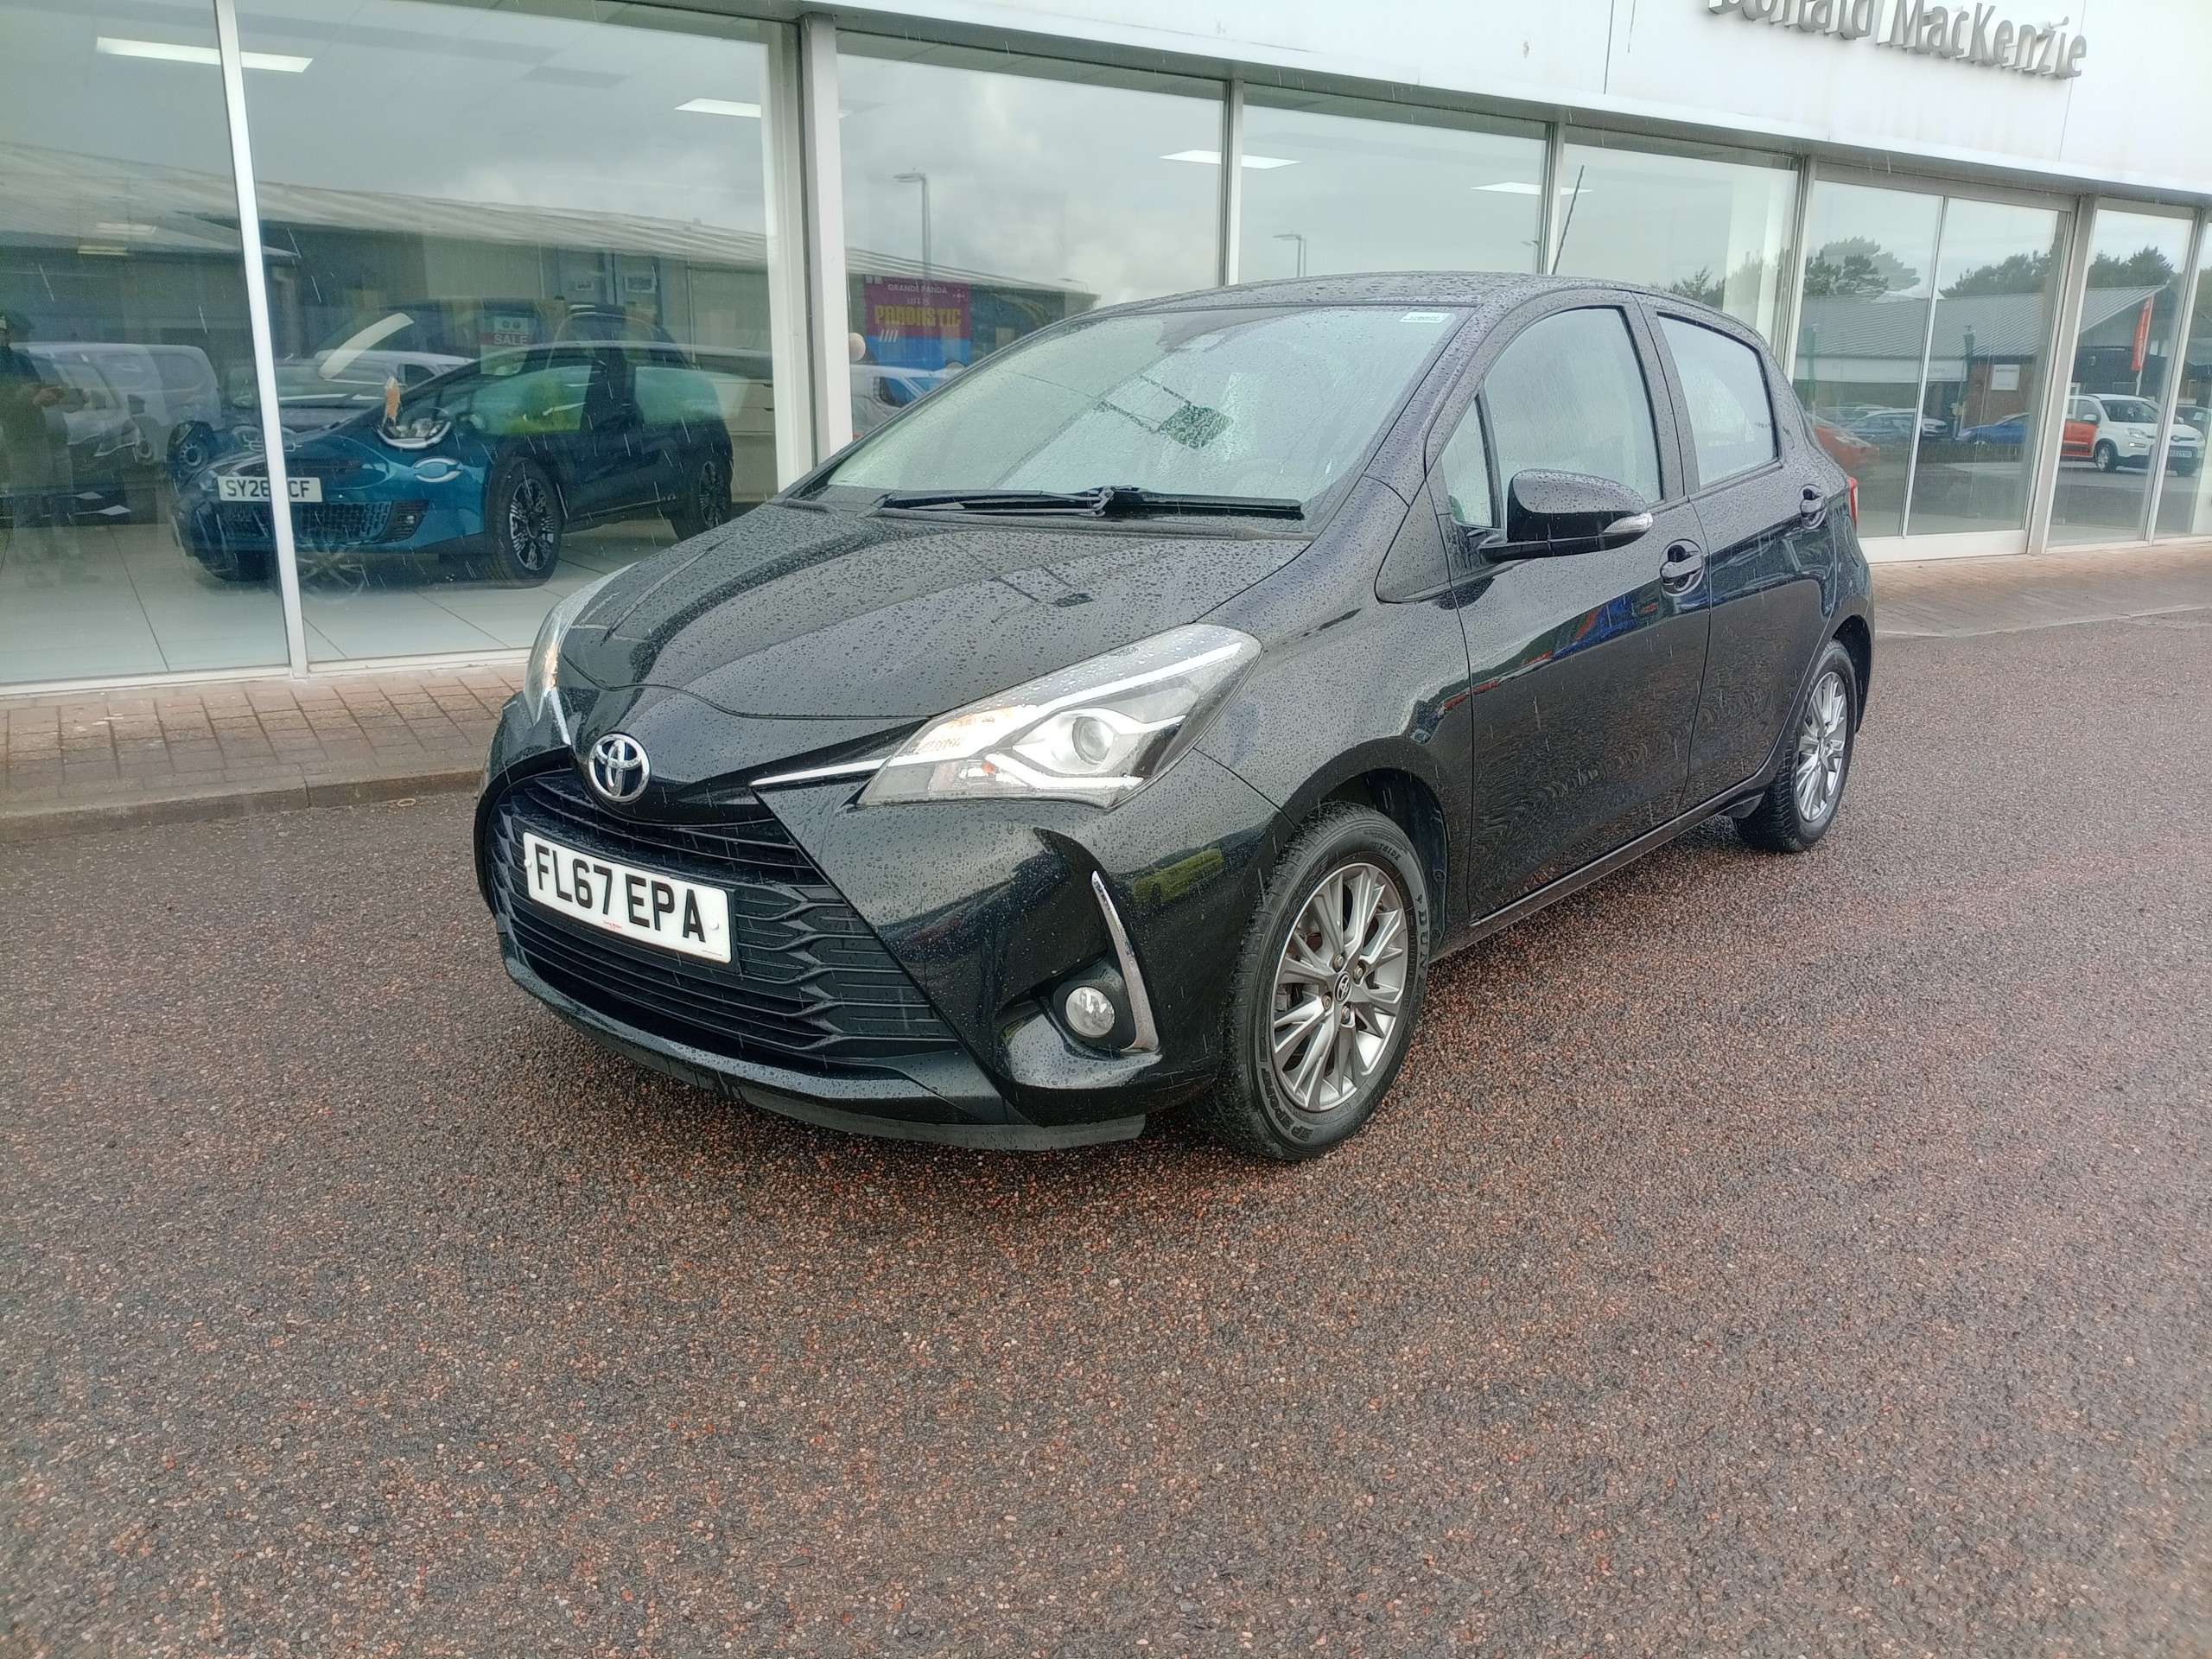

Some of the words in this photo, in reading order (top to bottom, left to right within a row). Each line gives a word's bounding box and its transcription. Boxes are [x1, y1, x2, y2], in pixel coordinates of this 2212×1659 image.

[1878, 0, 2088, 79] MacKenzie
[494, 334, 529, 346] SALE
[534, 843, 613, 915] FL67
[625, 873, 706, 943] EPA
